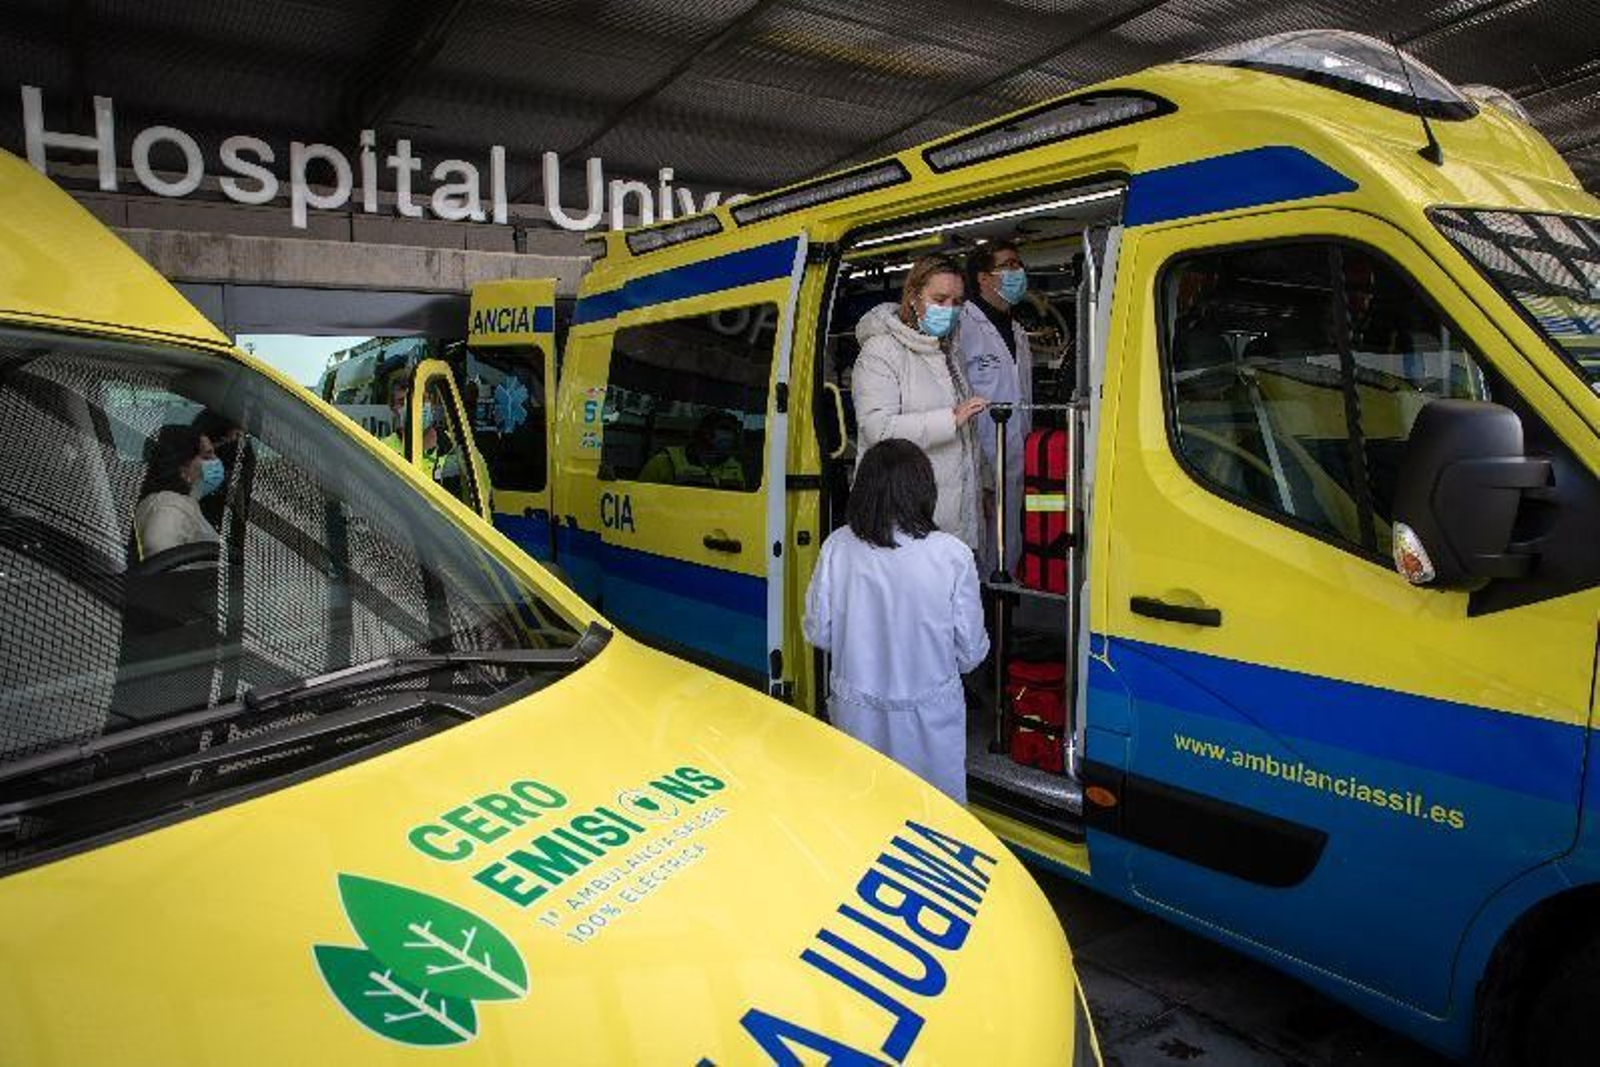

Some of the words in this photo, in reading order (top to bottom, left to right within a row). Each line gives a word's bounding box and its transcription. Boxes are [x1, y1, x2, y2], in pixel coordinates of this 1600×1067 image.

[21, 85, 508, 228] Hospital
[468, 306, 530, 335] ANCIA
[600, 494, 635, 532] CIA
[1174, 733, 1465, 829] www.ambulanciassil.es
[408, 780, 568, 862] CERO
[566, 836, 675, 911] AMBULANCIA
[566, 904, 622, 944] 100%
